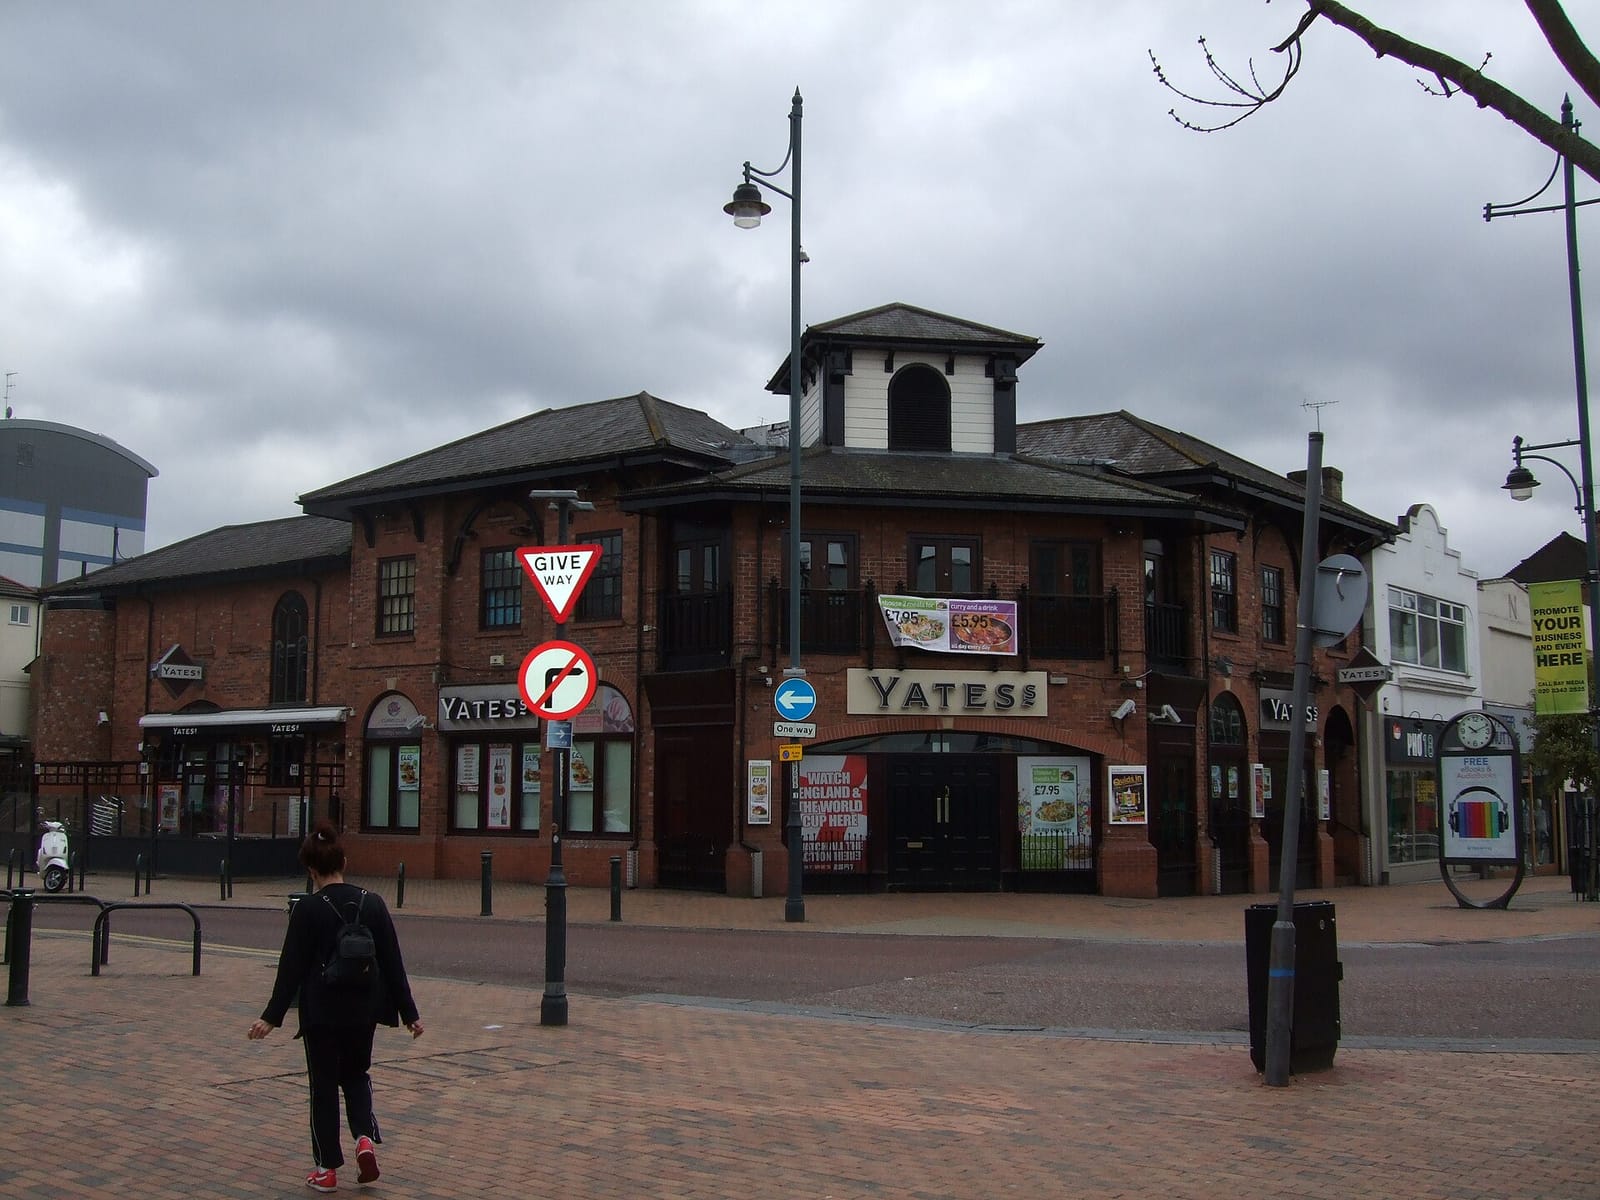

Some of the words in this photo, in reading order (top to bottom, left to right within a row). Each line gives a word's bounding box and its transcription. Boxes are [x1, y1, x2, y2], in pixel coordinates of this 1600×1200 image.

[534, 555, 581, 571] GIVE
[543, 574, 572, 585] WAY
[1533, 605, 1579, 616] PROMOTE
[952, 614, 989, 628] £5.95
[1533, 616, 1581, 631] YOUR
[1535, 632, 1582, 642] BUSINESS
[1535, 643, 1552, 651] AND
[1555, 642, 1582, 650] EVENT
[1537, 652, 1583, 668] HERE
[777, 724, 793, 732] One
[796, 727, 813, 735] way
[1463, 757, 1488, 765] FREE
[807, 771, 850, 785] WATCH
[799, 786, 850, 799] ENGLAND
[852, 787, 861, 798] &
[1034, 785, 1059, 795] £7.95
[820, 800, 863, 812] WORLD
[802, 815, 827, 828] CUP
